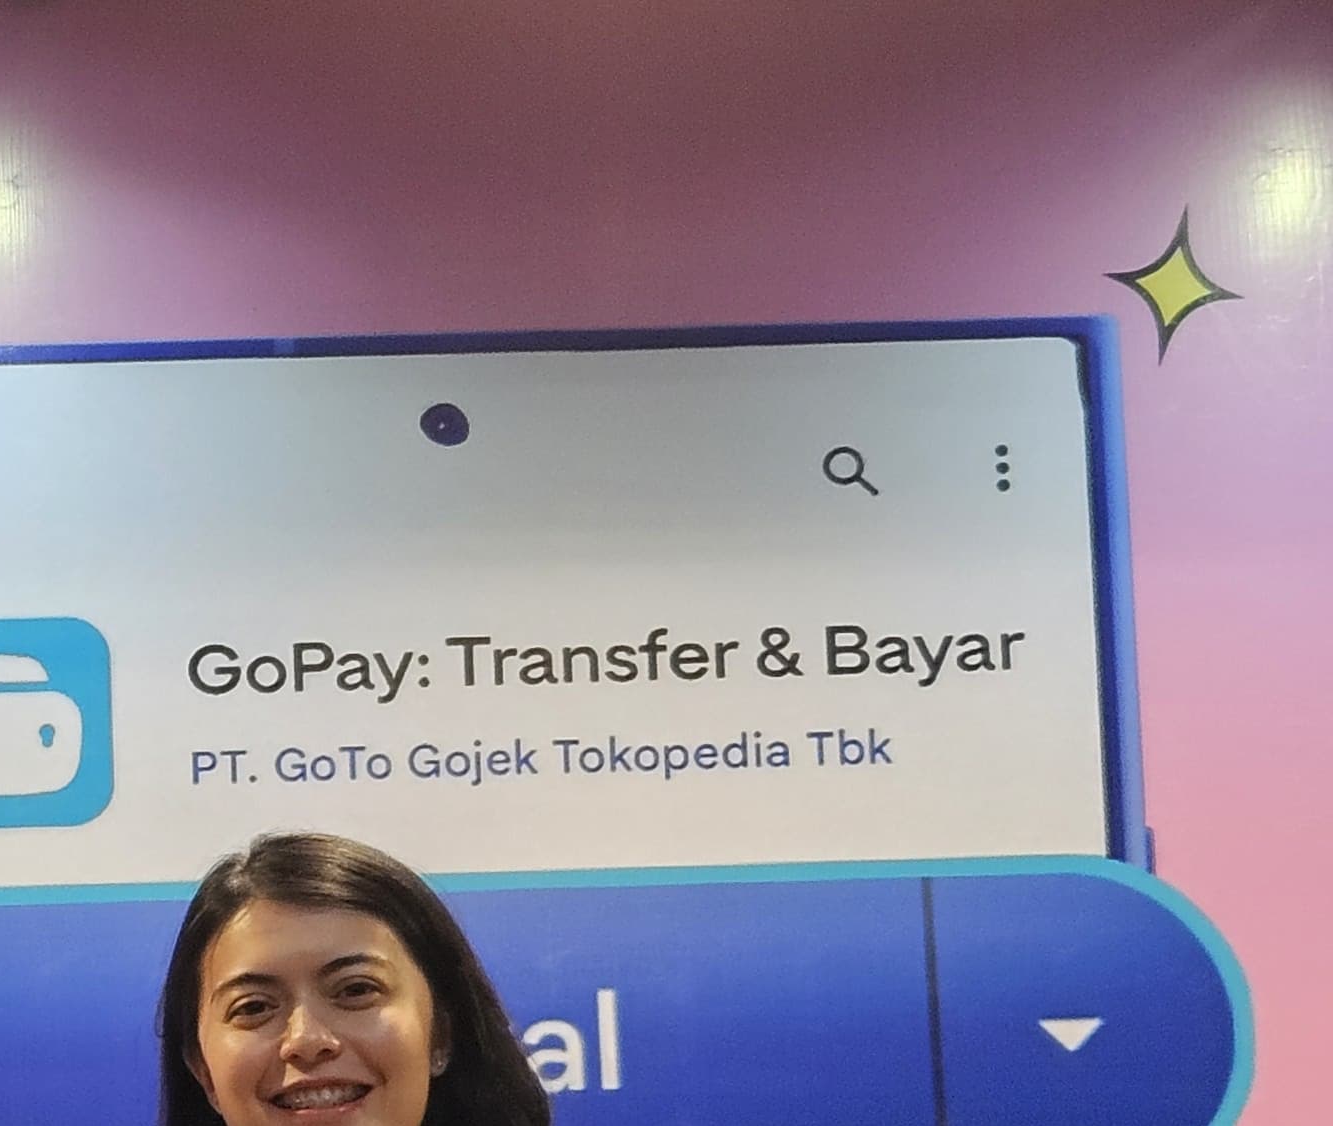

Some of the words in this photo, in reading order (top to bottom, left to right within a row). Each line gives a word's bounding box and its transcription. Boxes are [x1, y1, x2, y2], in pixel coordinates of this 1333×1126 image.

[187, 640, 432, 704] GoPay:
[446, 627, 740, 688] Transfer
[756, 627, 802, 680] &
[824, 623, 1026, 687] Bayar
[190, 748, 259, 786] PT.
[274, 743, 392, 782] GoTo
[408, 738, 539, 786] Gojek
[552, 731, 791, 780] Tokopedia
[806, 728, 894, 767] Tbk
